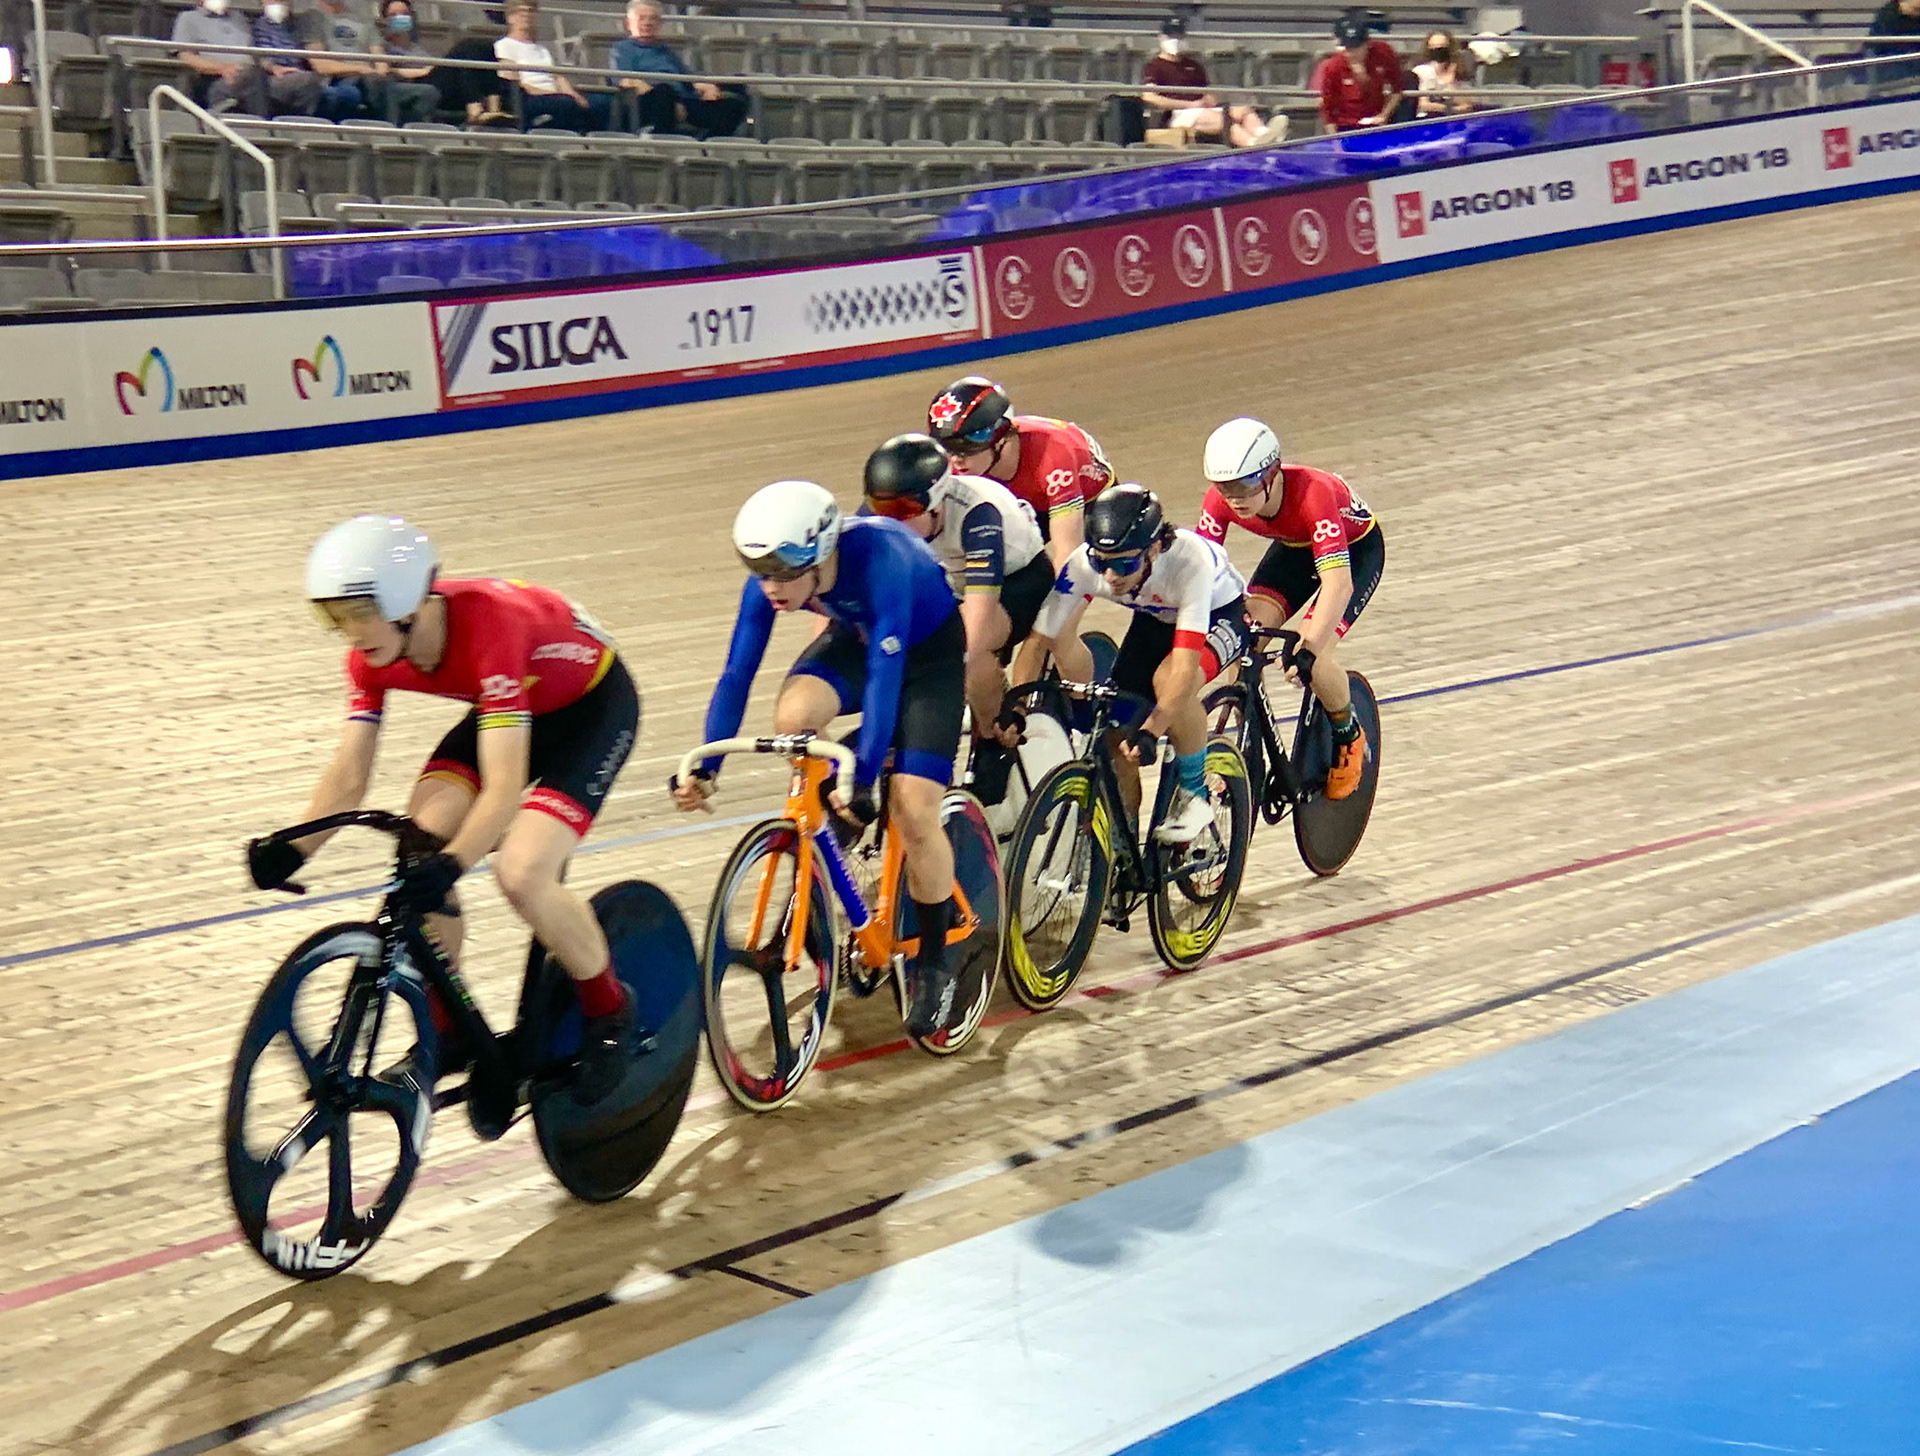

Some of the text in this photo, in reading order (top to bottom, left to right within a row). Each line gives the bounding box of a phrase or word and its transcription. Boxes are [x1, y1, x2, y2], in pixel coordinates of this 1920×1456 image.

[1644, 148, 1790, 188] ARGON 18
[1429, 180, 1574, 222] ARGON 18
[490, 315, 628, 375] SILCA
[178, 383, 247, 411] MILTON
[349, 370, 412, 396] MILTON
[0, 398, 66, 425] ILTON
